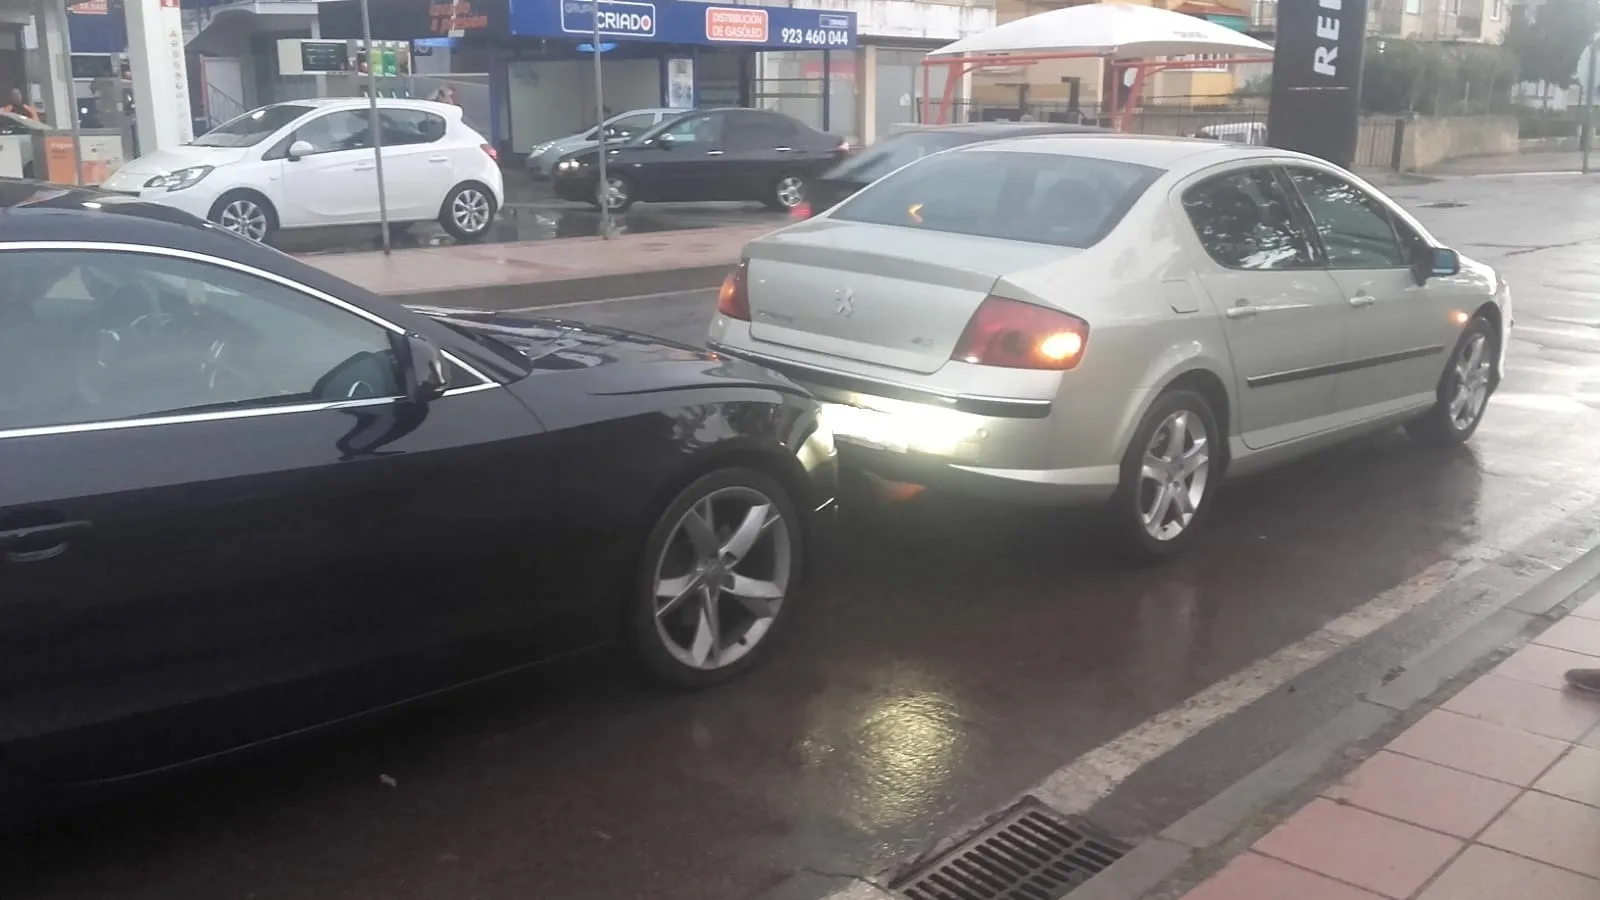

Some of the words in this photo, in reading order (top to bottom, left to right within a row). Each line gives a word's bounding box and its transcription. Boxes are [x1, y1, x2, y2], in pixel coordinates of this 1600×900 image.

[597, 12, 651, 31] CRIADO
[712, 26, 724, 37] DE
[725, 25, 762, 39] GASÓLEO
[782, 28, 803, 43] 923
[805, 29, 826, 45] 460
[828, 30, 849, 46] 044
